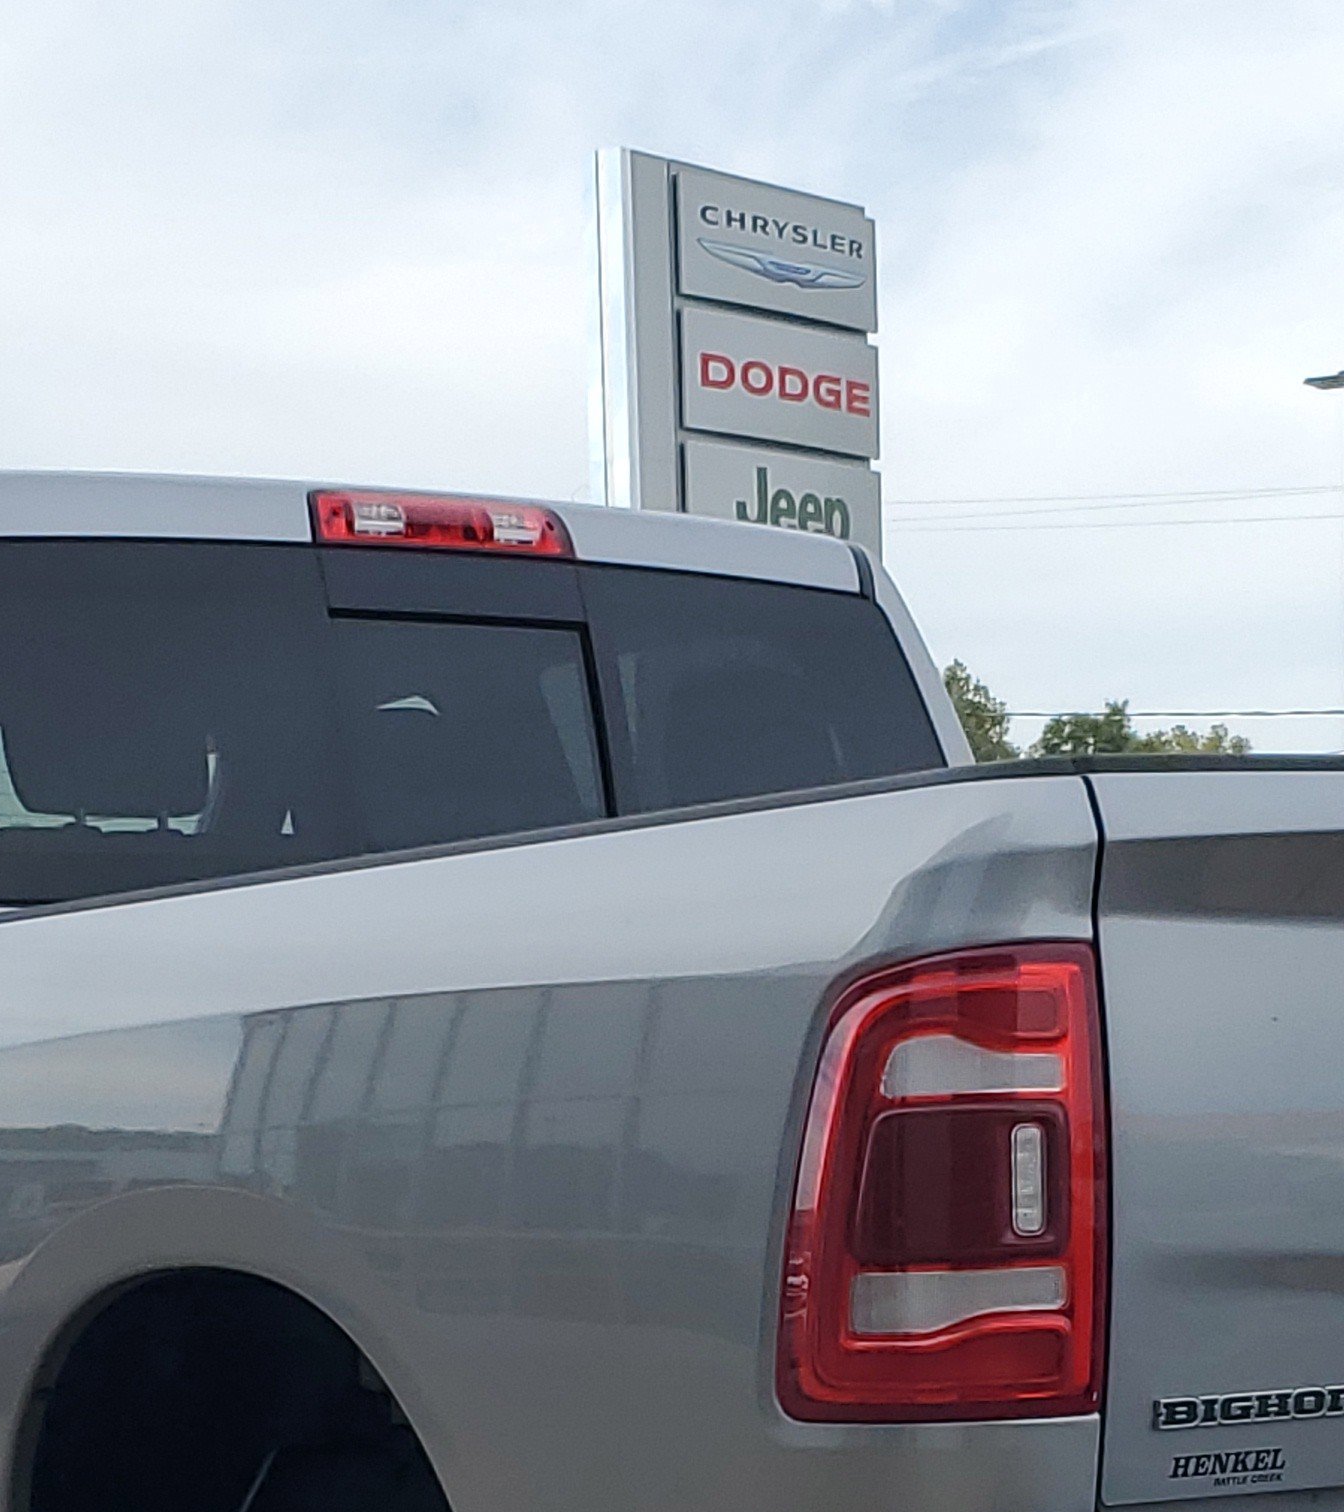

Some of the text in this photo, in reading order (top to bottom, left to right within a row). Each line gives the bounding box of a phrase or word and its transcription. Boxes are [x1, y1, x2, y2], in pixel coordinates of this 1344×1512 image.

[699, 205, 863, 259] CHRYSLER
[700, 352, 871, 417] DODGE
[1168, 1448, 1286, 1478] HENKEL
